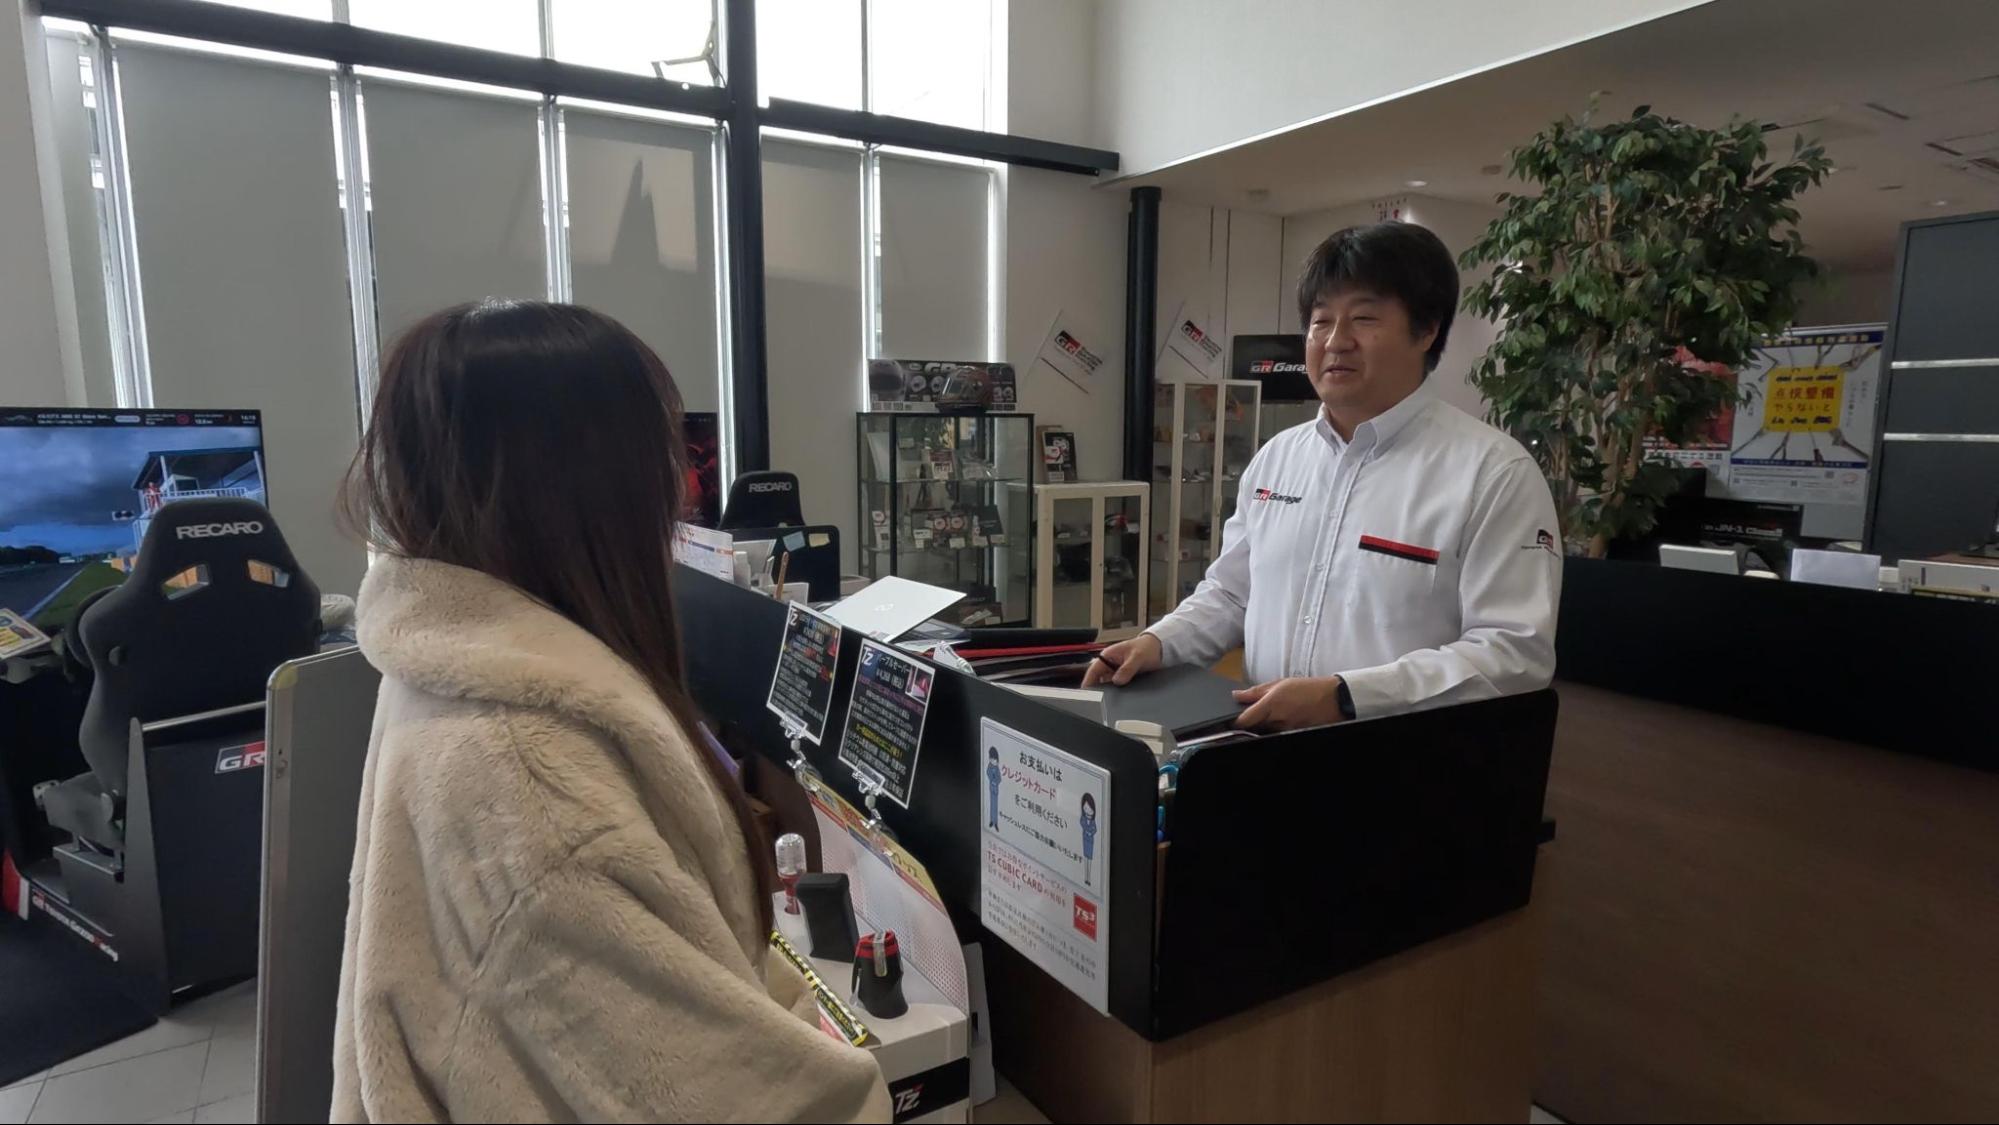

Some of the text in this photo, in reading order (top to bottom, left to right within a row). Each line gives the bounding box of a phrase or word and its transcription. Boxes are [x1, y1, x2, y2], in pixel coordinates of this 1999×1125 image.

[1249, 362, 1308, 375] GR Gara
[748, 481, 793, 493] RECARO
[1269, 492, 1303, 504] Garage
[175, 520, 264, 540] RECARO
[218, 750, 266, 771] GR
[1019, 751, 1063, 782] お支払いは
[1001, 765, 1057, 800] クレジットカード
[1014, 793, 1068, 829] をご利用ください
[987, 851, 997, 864] TS
[997, 858, 1021, 879] CUBIC
[1021, 871, 1043, 893] CARD
